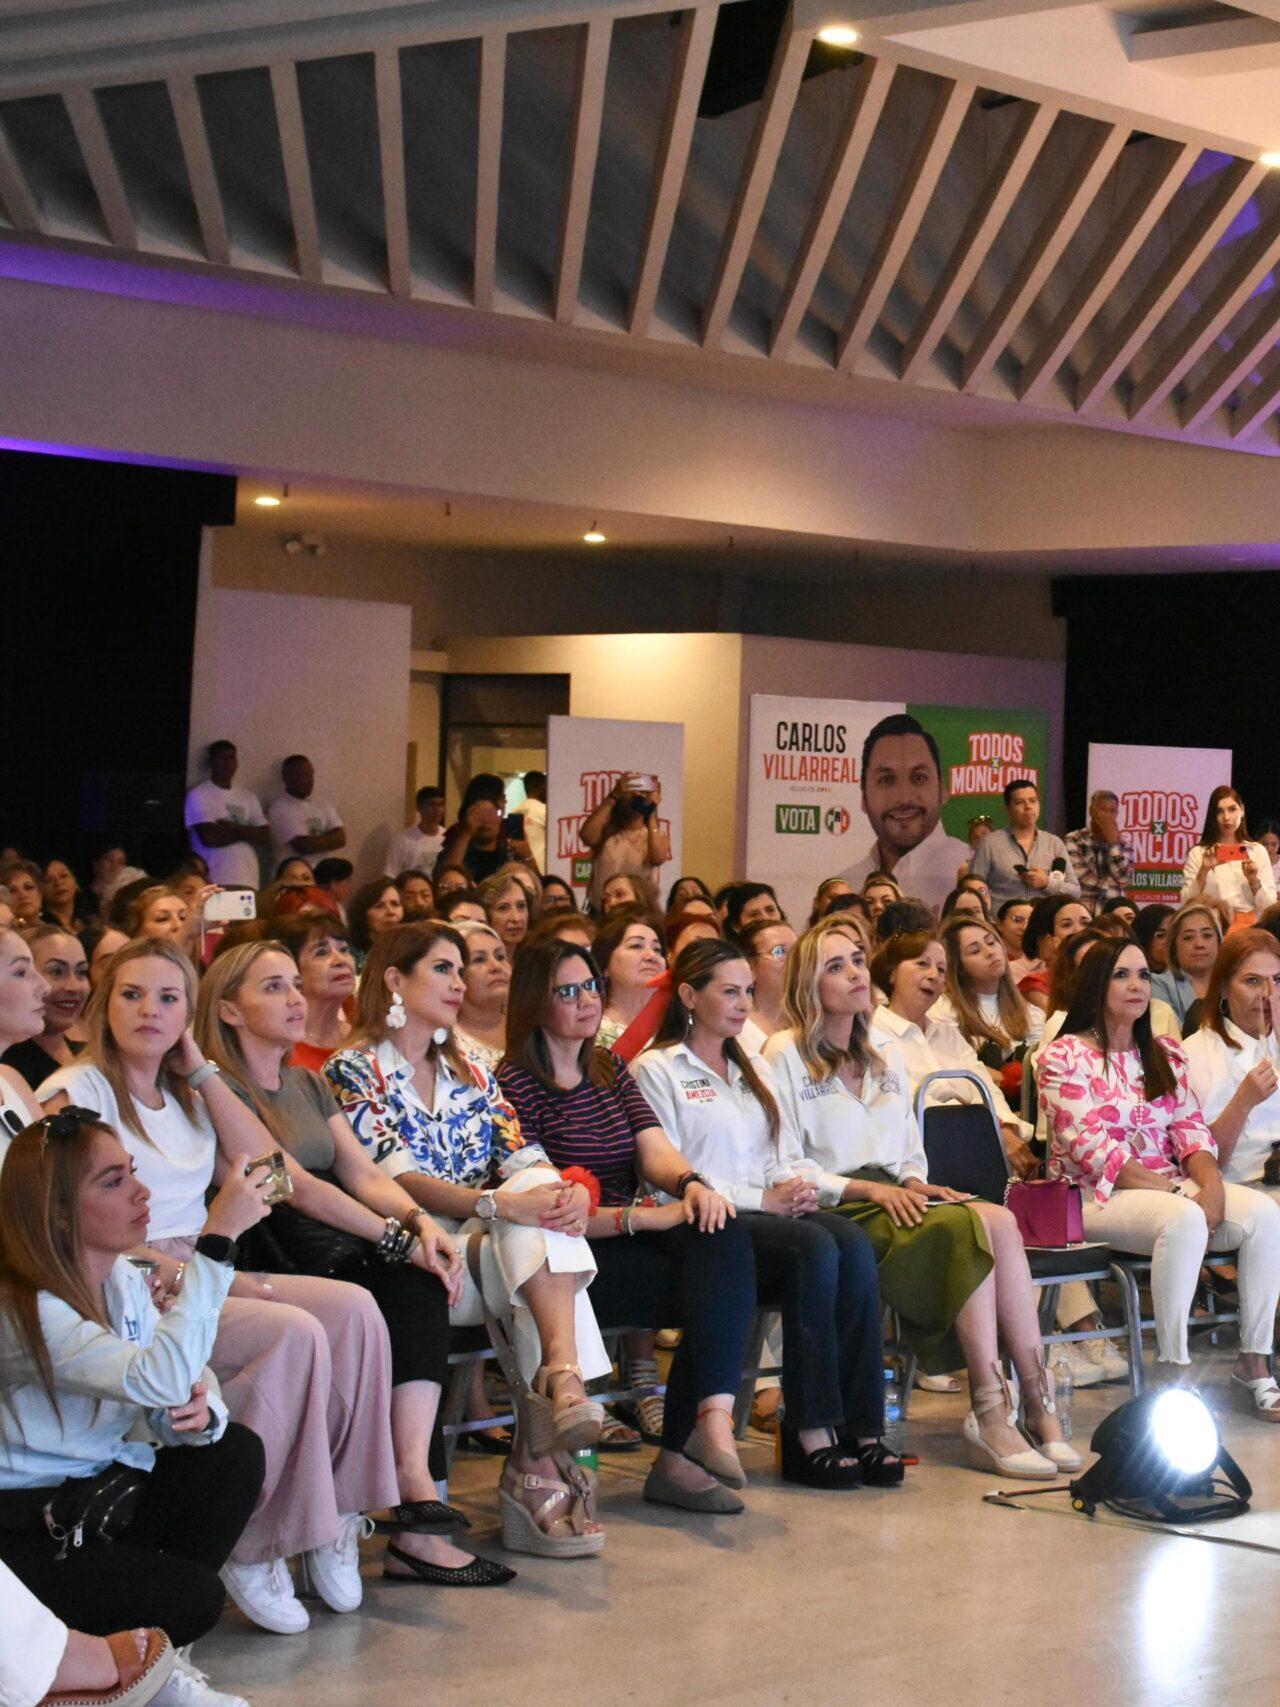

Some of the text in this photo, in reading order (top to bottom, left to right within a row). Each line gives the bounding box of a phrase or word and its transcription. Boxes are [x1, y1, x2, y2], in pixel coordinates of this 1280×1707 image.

[776, 721, 847, 753] CARLOS
[969, 733, 1024, 763] TODOS
[763, 753, 859, 783] VILLARREAL
[779, 807, 816, 831] VOTA
[1121, 791, 1198, 830] TODOS
[1132, 873, 1148, 886] LOS
